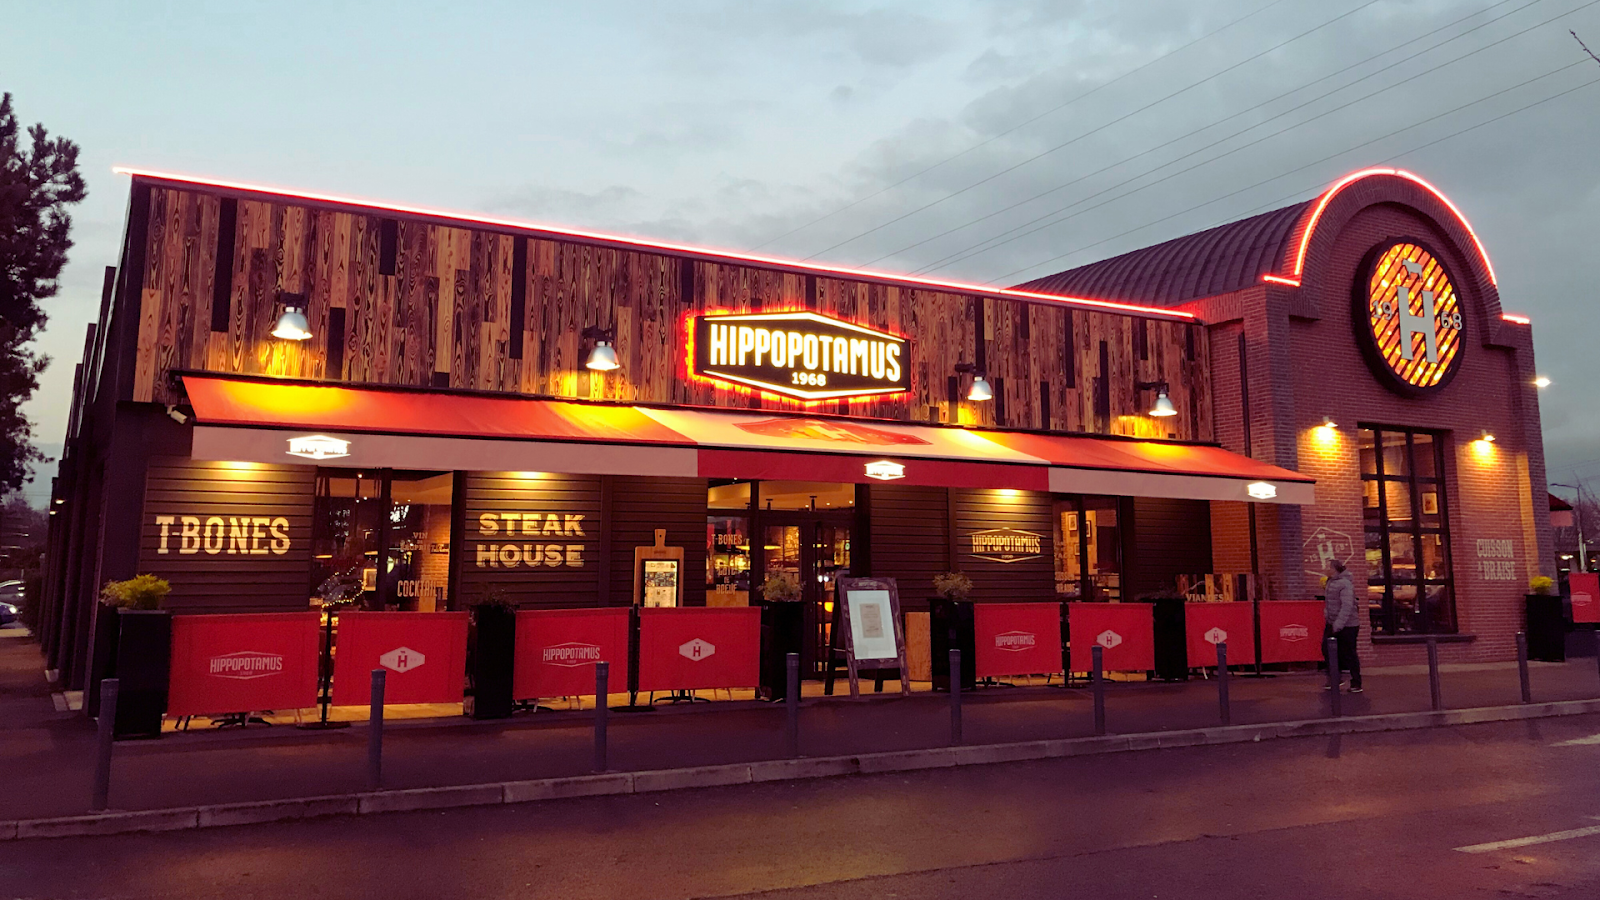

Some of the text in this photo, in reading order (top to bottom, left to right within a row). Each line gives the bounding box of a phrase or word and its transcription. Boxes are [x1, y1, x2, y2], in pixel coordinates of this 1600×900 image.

[1372, 285, 1463, 363] 19 H 68
[710, 323, 902, 383] HIPPOPOTAMUS
[791, 371, 827, 387] 1968
[479, 513, 586, 537] STEAK
[155, 515, 291, 555] T-BONES
[711, 534, 743, 545] T-BONES
[972, 534, 1041, 554] HIPPOPOTAMUS
[476, 544, 585, 568] HOUSE
[1483, 561, 1517, 580] BRAISE
[1106, 636, 1112, 645] H
[1213, 633, 1219, 642] H
[542, 647, 601, 661] HIPPOPOTAMUS
[693, 646, 701, 657] H
[209, 656, 283, 674] HIPPOPOTAMUS
[397, 655, 407, 668] H
